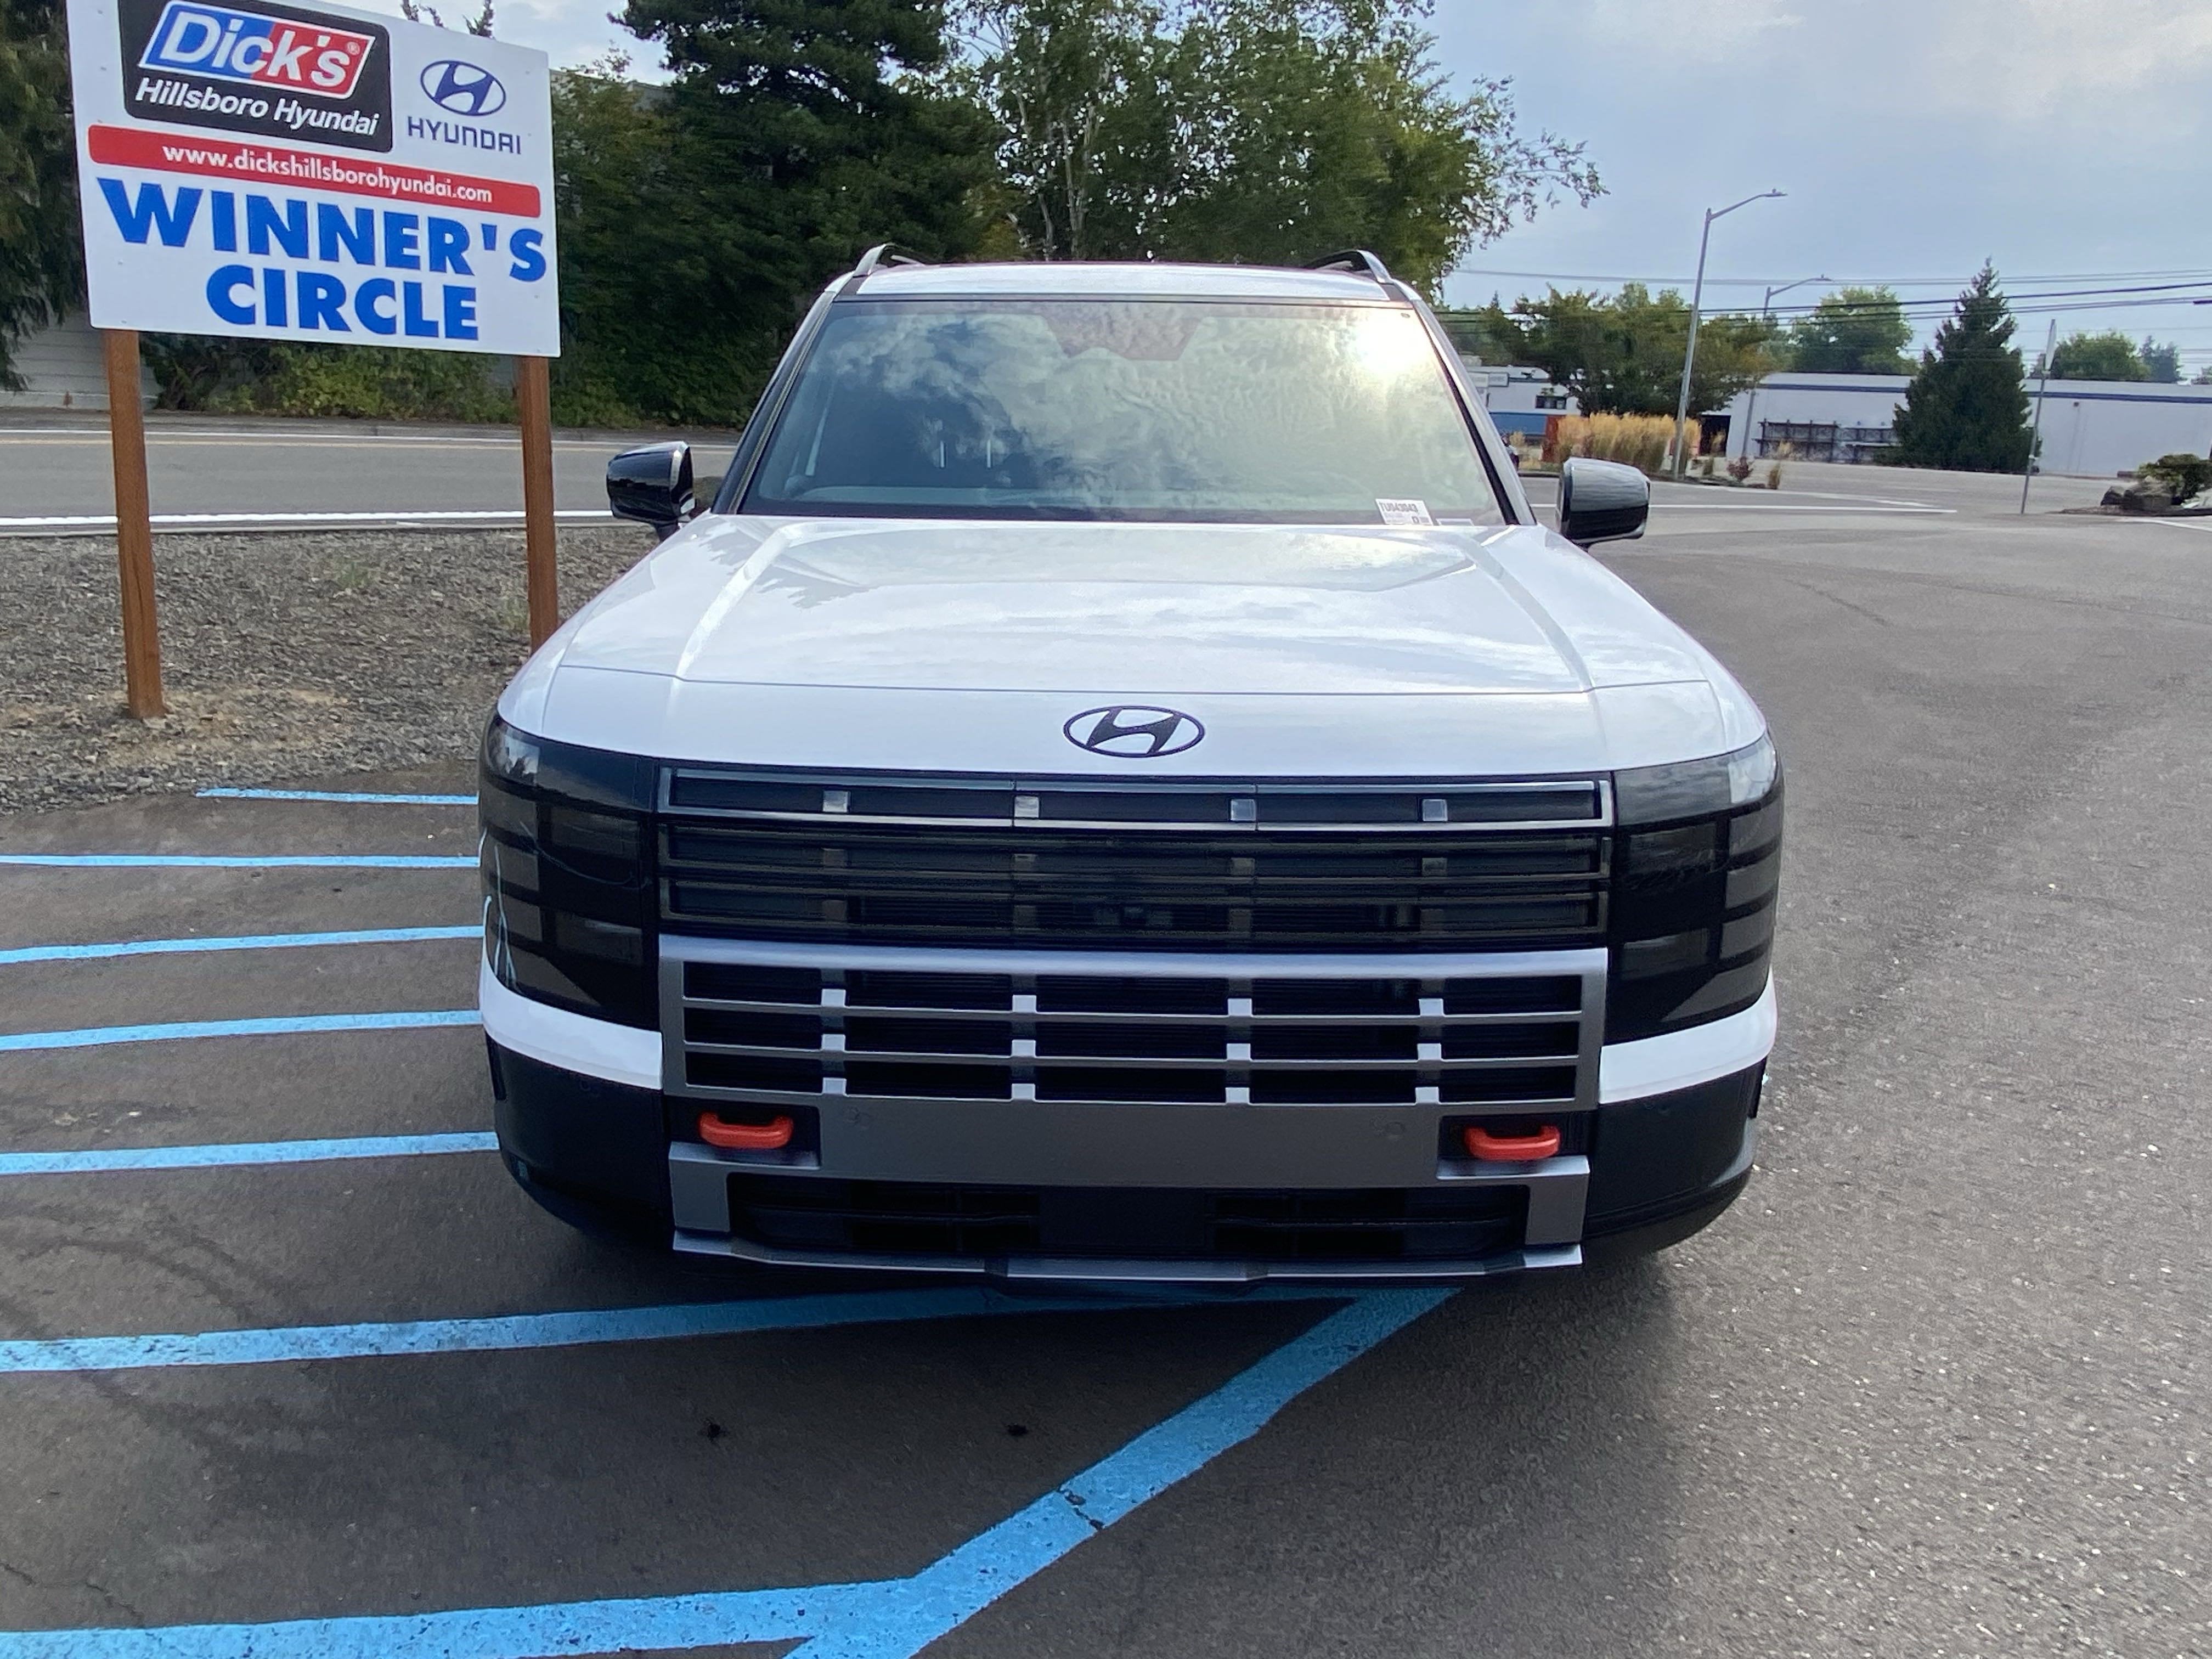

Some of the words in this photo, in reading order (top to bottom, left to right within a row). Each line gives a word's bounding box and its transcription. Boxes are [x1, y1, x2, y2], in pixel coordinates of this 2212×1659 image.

[136, 77, 269, 118] Hillsboro
[274, 98, 380, 136] Hyundai
[408, 116, 521, 154] HYUNDAI
[162, 145, 492, 204] www.dickshillsborohyundai.com
[97, 177, 546, 282] WINNER'S
[206, 264, 479, 341] CIRCLE
